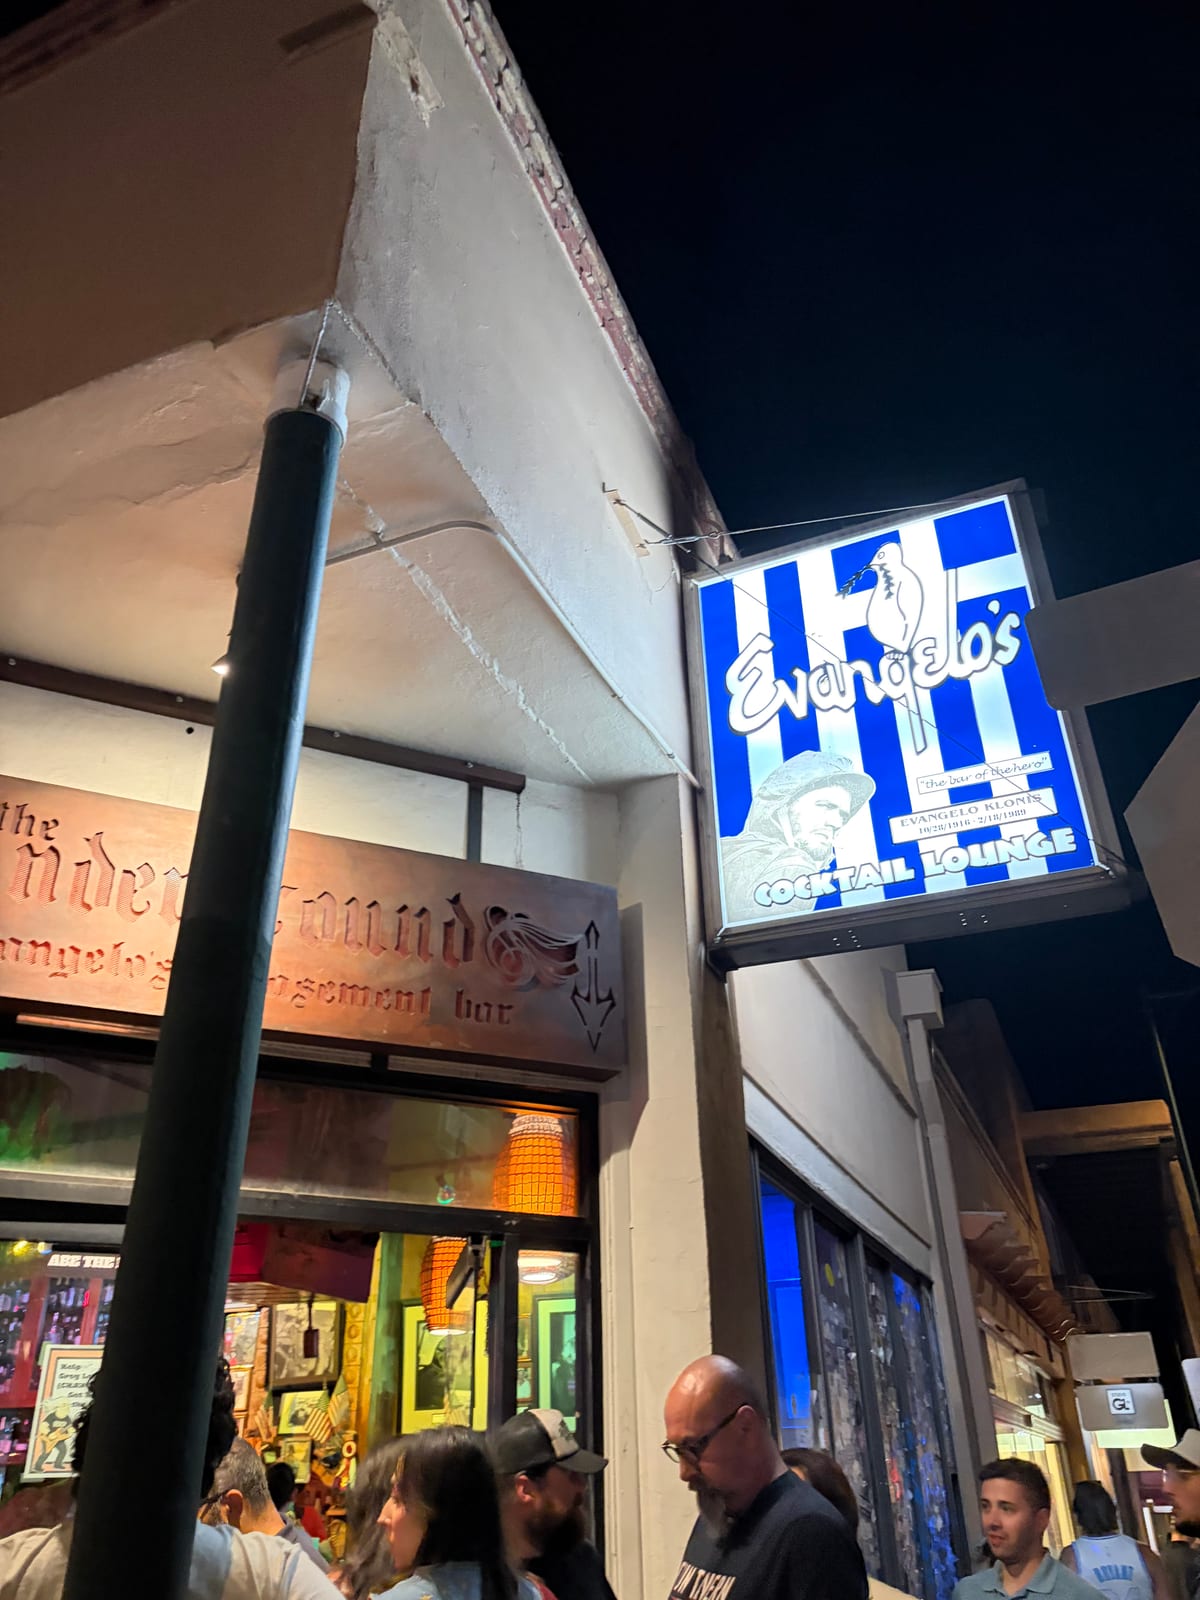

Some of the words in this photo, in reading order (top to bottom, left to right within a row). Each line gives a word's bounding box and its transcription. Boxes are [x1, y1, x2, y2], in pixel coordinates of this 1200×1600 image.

[725, 568, 1021, 755] Evangelo's
[949, 774, 972, 786] bar
[974, 768, 989, 782] of
[0, 801, 59, 841] the
[899, 805, 979, 828] EVANGELO
[984, 793, 1042, 812] KLONIS
[753, 857, 915, 907] COCKTAIL
[920, 827, 1077, 878] LOUNGE
[455, 988, 513, 1025] bar
